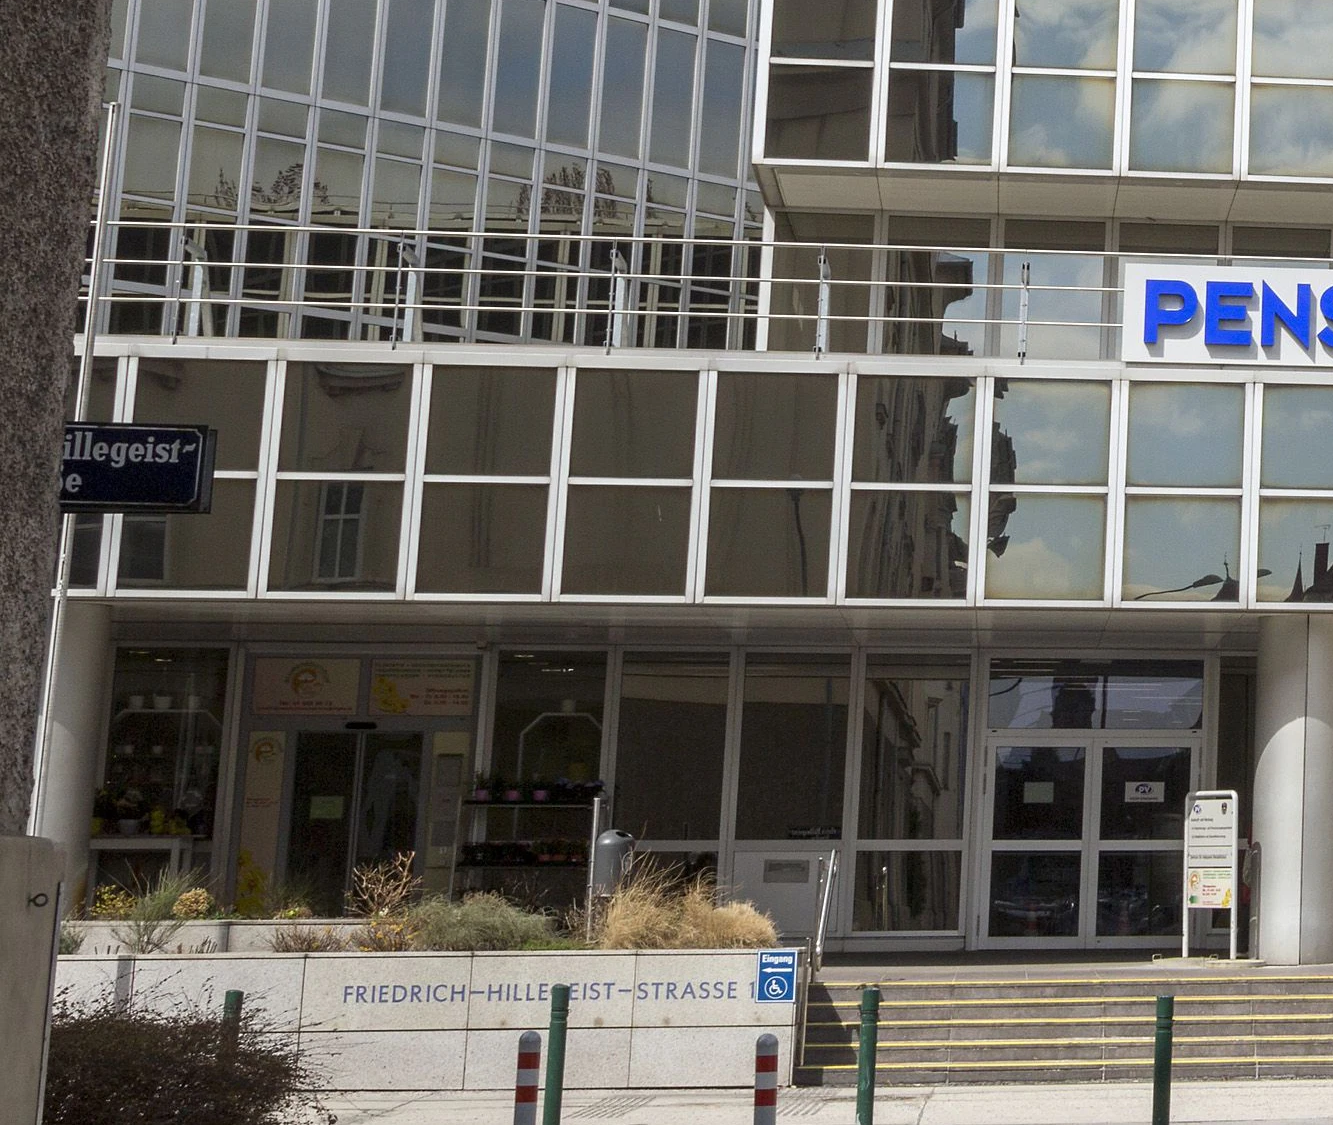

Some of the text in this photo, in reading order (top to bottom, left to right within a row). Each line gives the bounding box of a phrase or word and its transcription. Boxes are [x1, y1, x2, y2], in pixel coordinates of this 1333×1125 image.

[63, 431, 197, 468] illegeist-
[761, 954, 793, 965] Eingang
[342, 980, 738, 1004] FRIEDRICH-HILLEEIST-STRASSE
